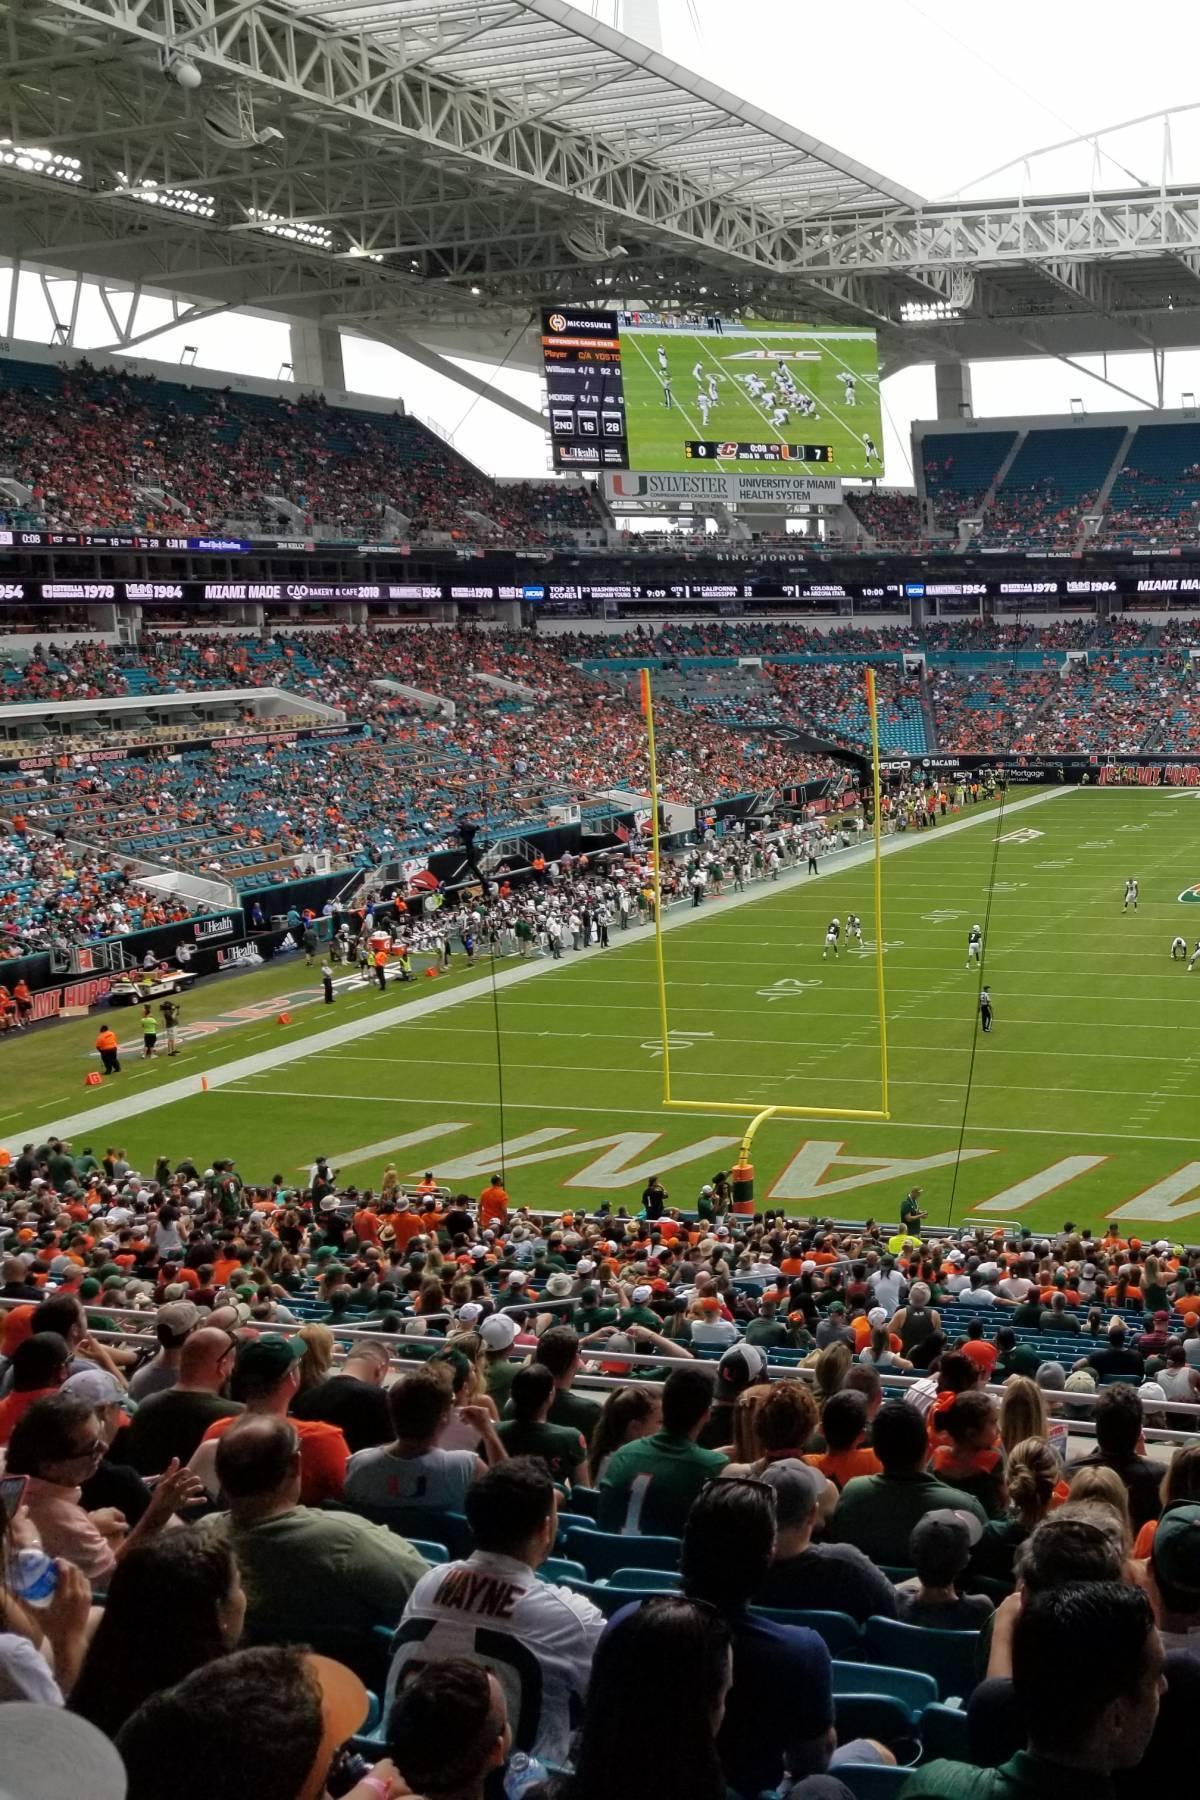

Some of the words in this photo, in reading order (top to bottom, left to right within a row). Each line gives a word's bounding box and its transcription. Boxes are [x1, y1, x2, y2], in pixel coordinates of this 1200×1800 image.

[567, 320, 612, 330] MICCOSUKEE
[548, 394, 576, 402] MOORE
[554, 421, 573, 430] 2ND
[582, 421, 594, 432] 16
[699, 446, 706, 456] 0
[814, 449, 822, 459] 7
[650, 477, 728, 494] SYLVESTER
[739, 477, 790, 490] UNIVERSITY
[793, 479, 804, 490] OF
[806, 479, 837, 491] MIAMI
[739, 489, 768, 500] HEALTH
[769, 490, 810, 501] SYSTEM
[86, 537, 92, 545] 2
[110, 538, 119, 547] 16
[760, 553, 804, 562] HONOR
[962, 584, 987, 594] 1954
[1033, 583, 1058, 593] 1978
[1090, 582, 1117, 593] 1984
[1137, 580, 1178, 591] MIAMI
[84, 585, 115, 599] 1978
[154, 585, 183, 599] 1984
[205, 585, 246, 599] MIAMI
[248, 585, 281, 599] MADE
[309, 588, 335, 597] BAKERY
[341, 588, 358, 597] CAFE
[358, 586, 379, 599] 2018
[422, 587, 442, 599] 1954
[475, 588, 494, 599] 1978
[647, 590, 666, 598] 9:09
[862, 589, 884, 598] 10:00
[1011, 769, 1045, 779] Mortgage
[621, 1472, 654, 1537] 1
[431, 1569, 528, 1621] WAYNE
